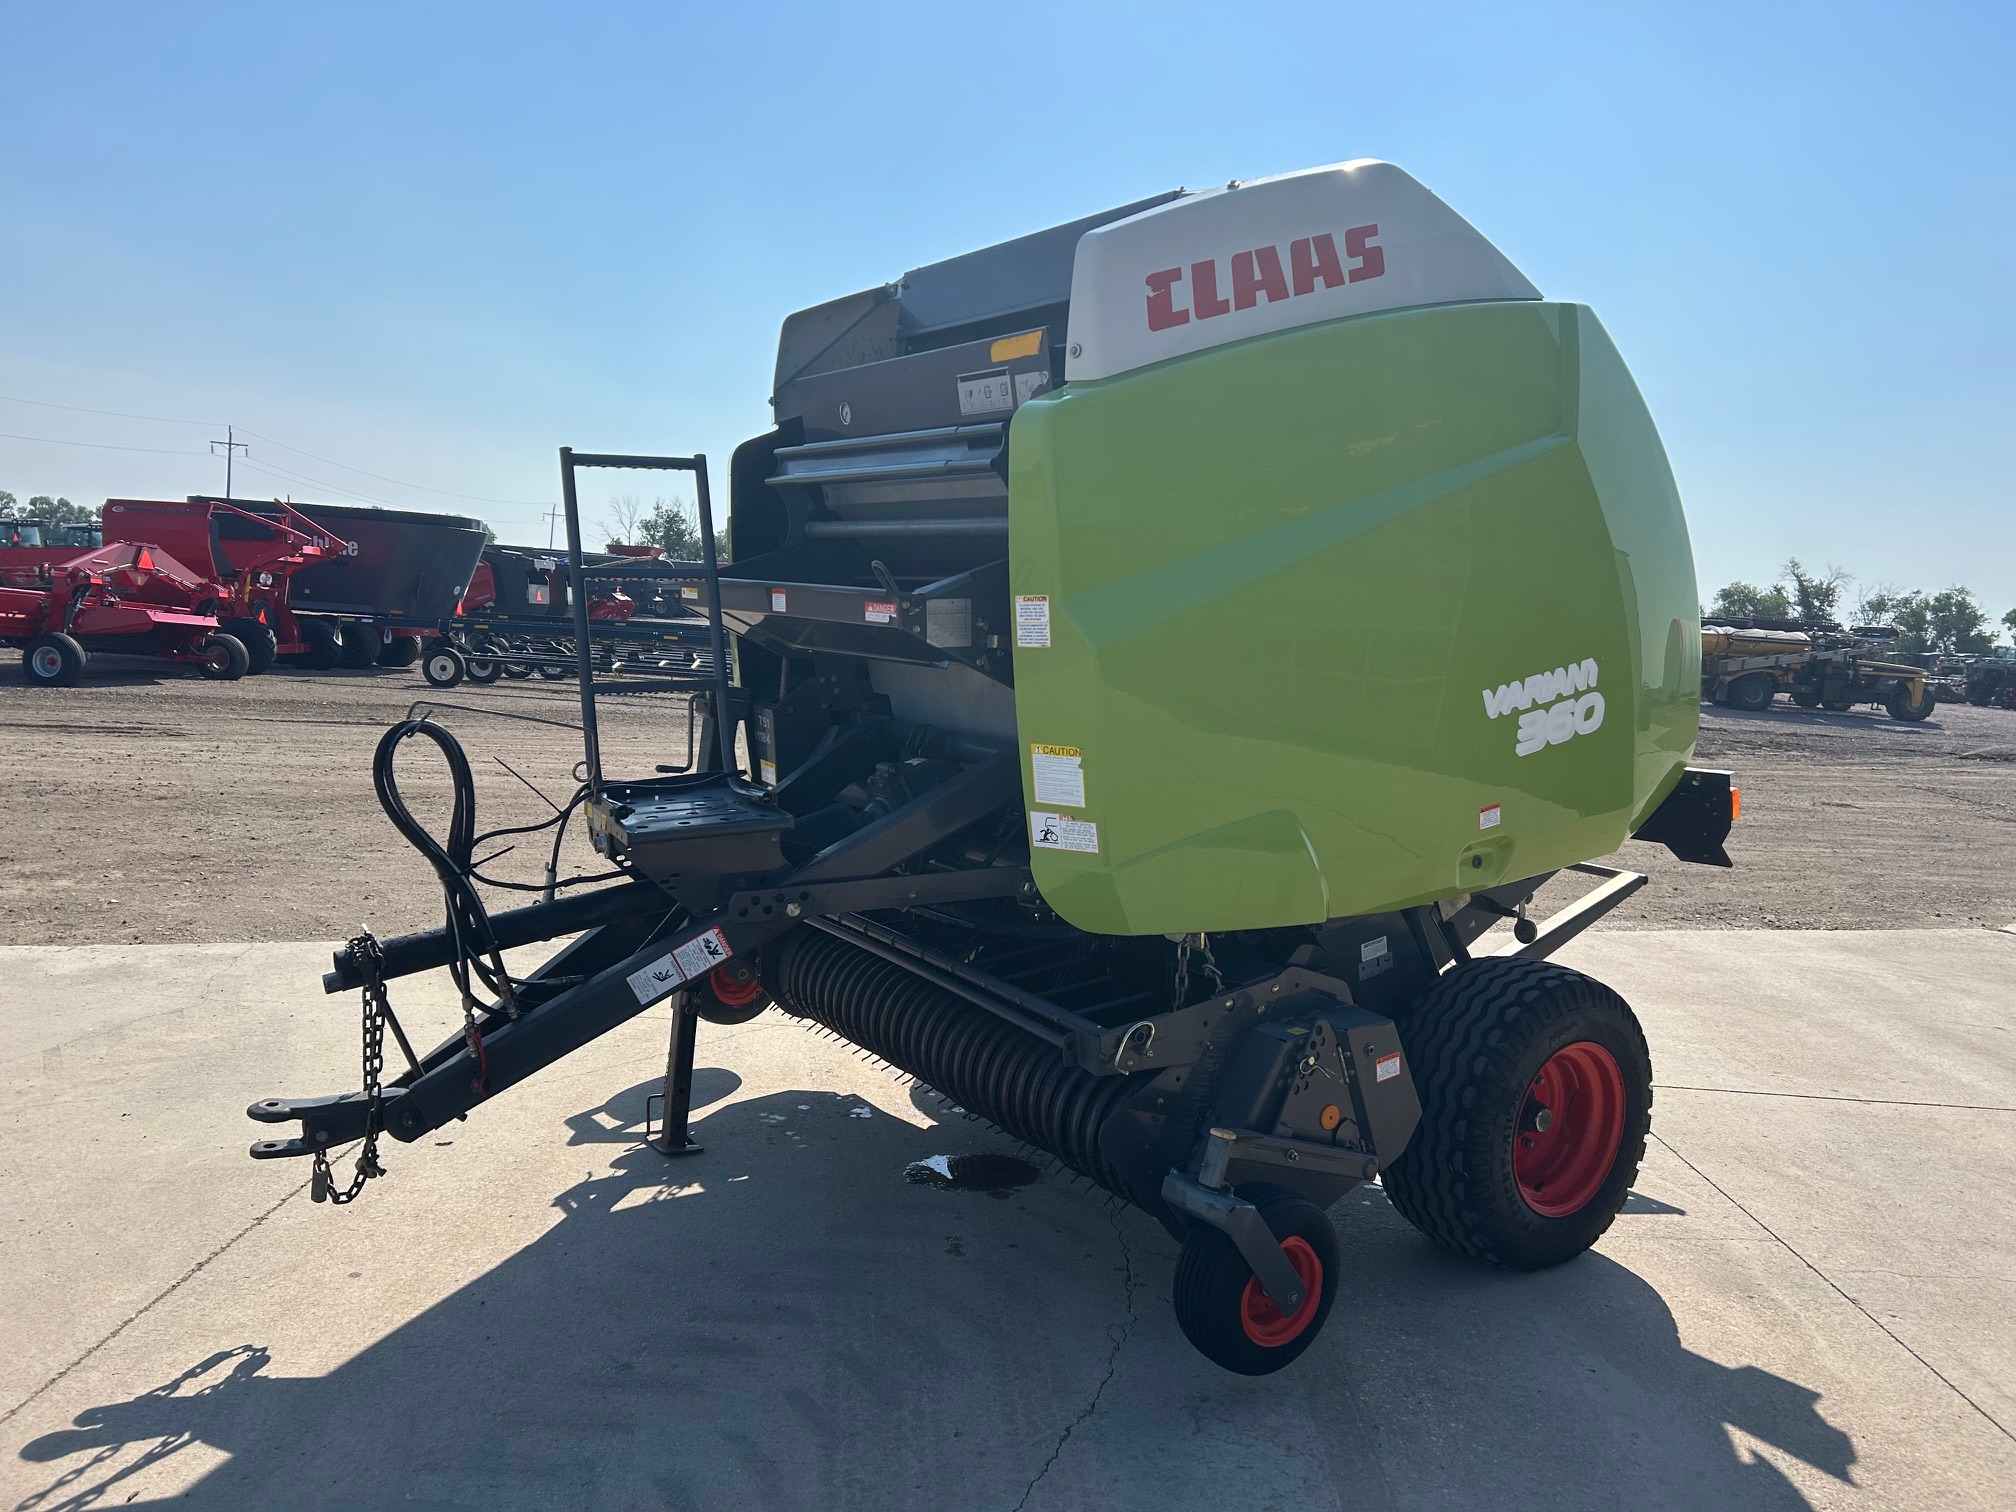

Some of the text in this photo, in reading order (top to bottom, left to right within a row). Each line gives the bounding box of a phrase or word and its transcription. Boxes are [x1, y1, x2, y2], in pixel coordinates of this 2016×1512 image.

[1145, 223, 1385, 332] CLAAS
[873, 603, 895, 614] DANGER
[758, 715, 770, 729] 751
[1515, 691, 1605, 757] 360
[1043, 746, 1082, 757] CAUTION
[716, 933, 732, 957] DANGER
[669, 959, 683, 982] WARNING
